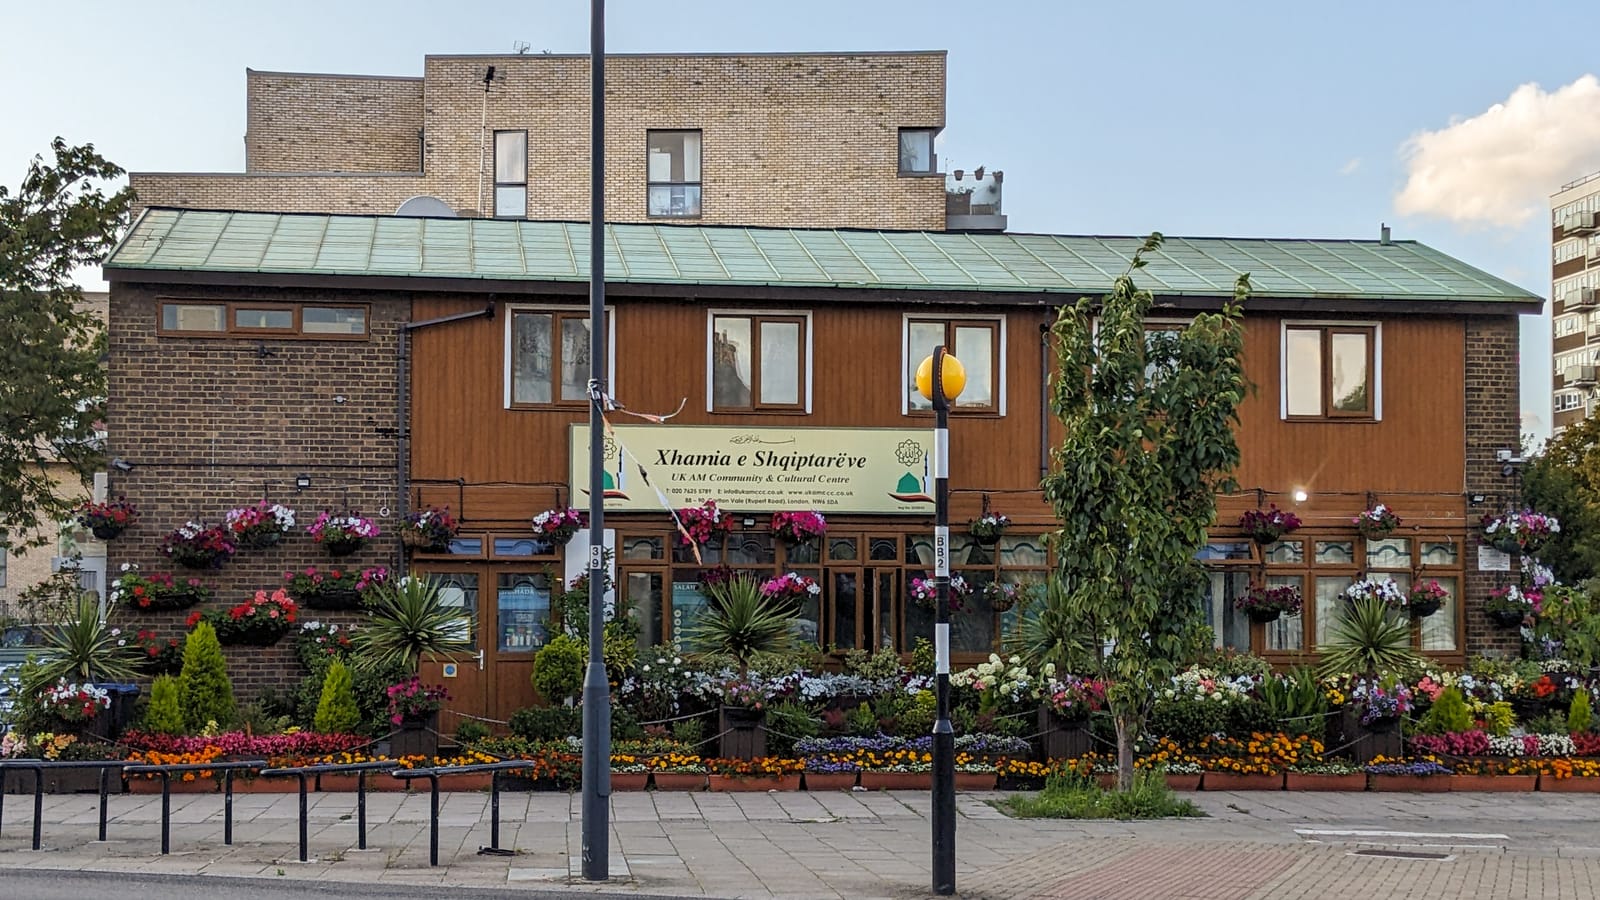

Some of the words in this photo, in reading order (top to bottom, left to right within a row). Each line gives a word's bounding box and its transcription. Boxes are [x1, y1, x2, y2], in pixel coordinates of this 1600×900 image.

[654, 449, 731, 466] Xhamia
[737, 454, 747, 466] e
[753, 450, 867, 471] Shqiptarëve
[709, 473, 763, 484] Community
[766, 474, 774, 482] &
[776, 474, 816, 483] Cultural
[818, 475, 850, 484] Centre
[592, 547, 599, 567] 39
